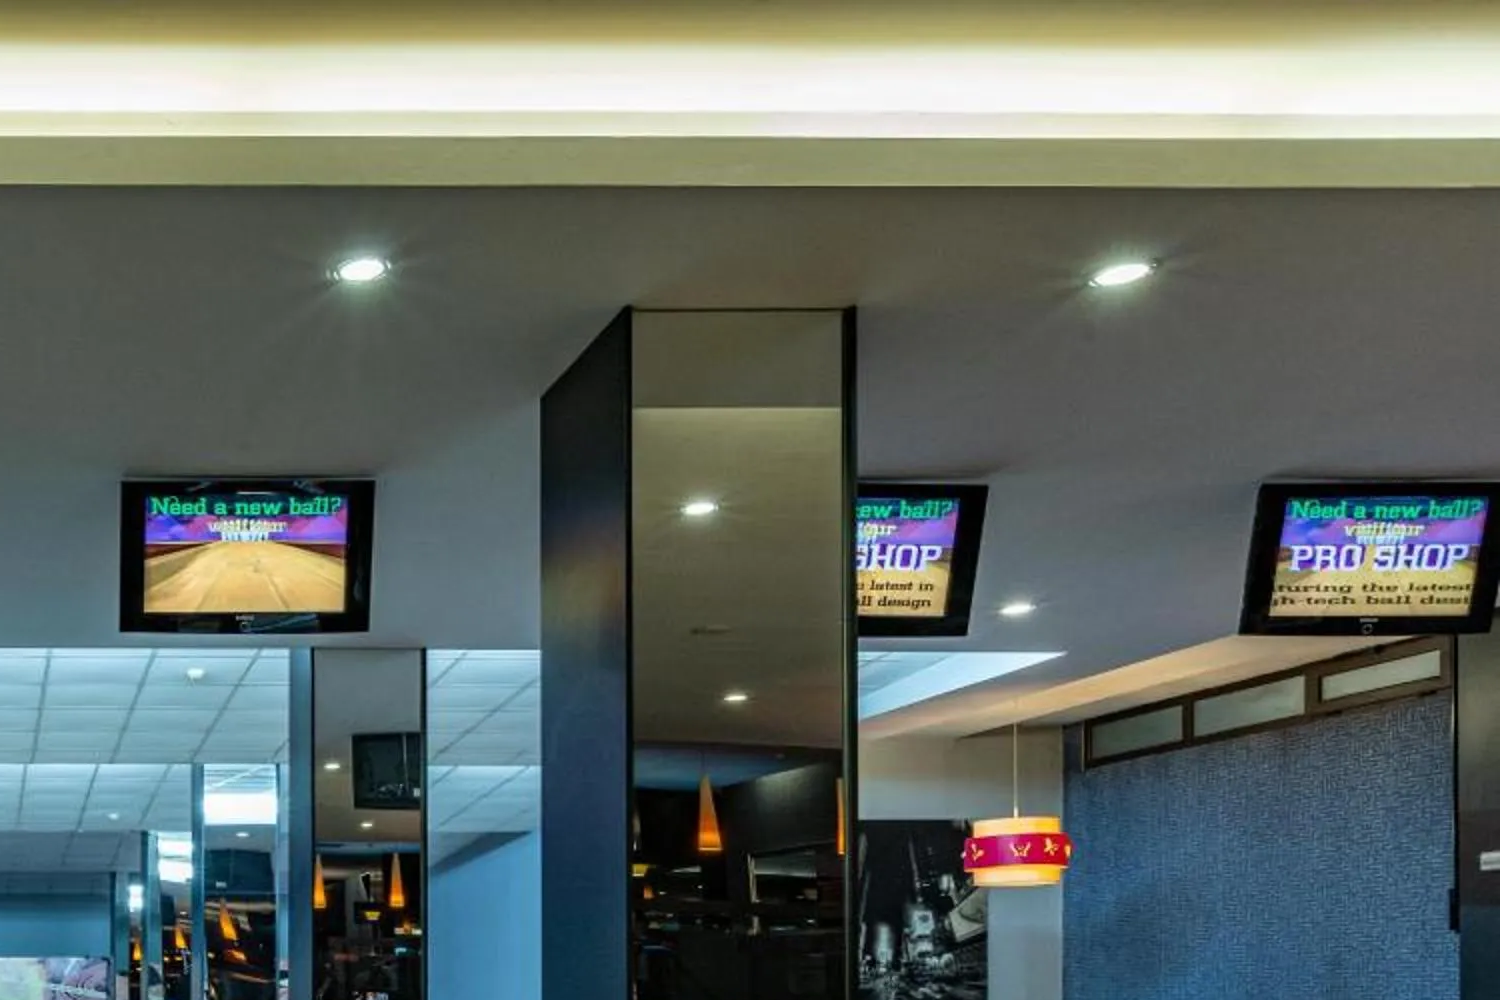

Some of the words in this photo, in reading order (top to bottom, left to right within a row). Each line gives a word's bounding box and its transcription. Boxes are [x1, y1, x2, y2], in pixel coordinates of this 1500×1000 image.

[150, 496, 207, 515] Need
[214, 502, 227, 515] a
[235, 502, 281, 515] new
[289, 497, 341, 515] ball?
[857, 505, 892, 518] ew
[900, 499, 953, 519] ball?
[1291, 500, 1347, 519] Need
[1353, 505, 1367, 519] a
[1374, 505, 1422, 519] new
[1428, 500, 1485, 520] ball?
[1289, 544, 1363, 572] PRO
[1372, 544, 1470, 573] SHOP
